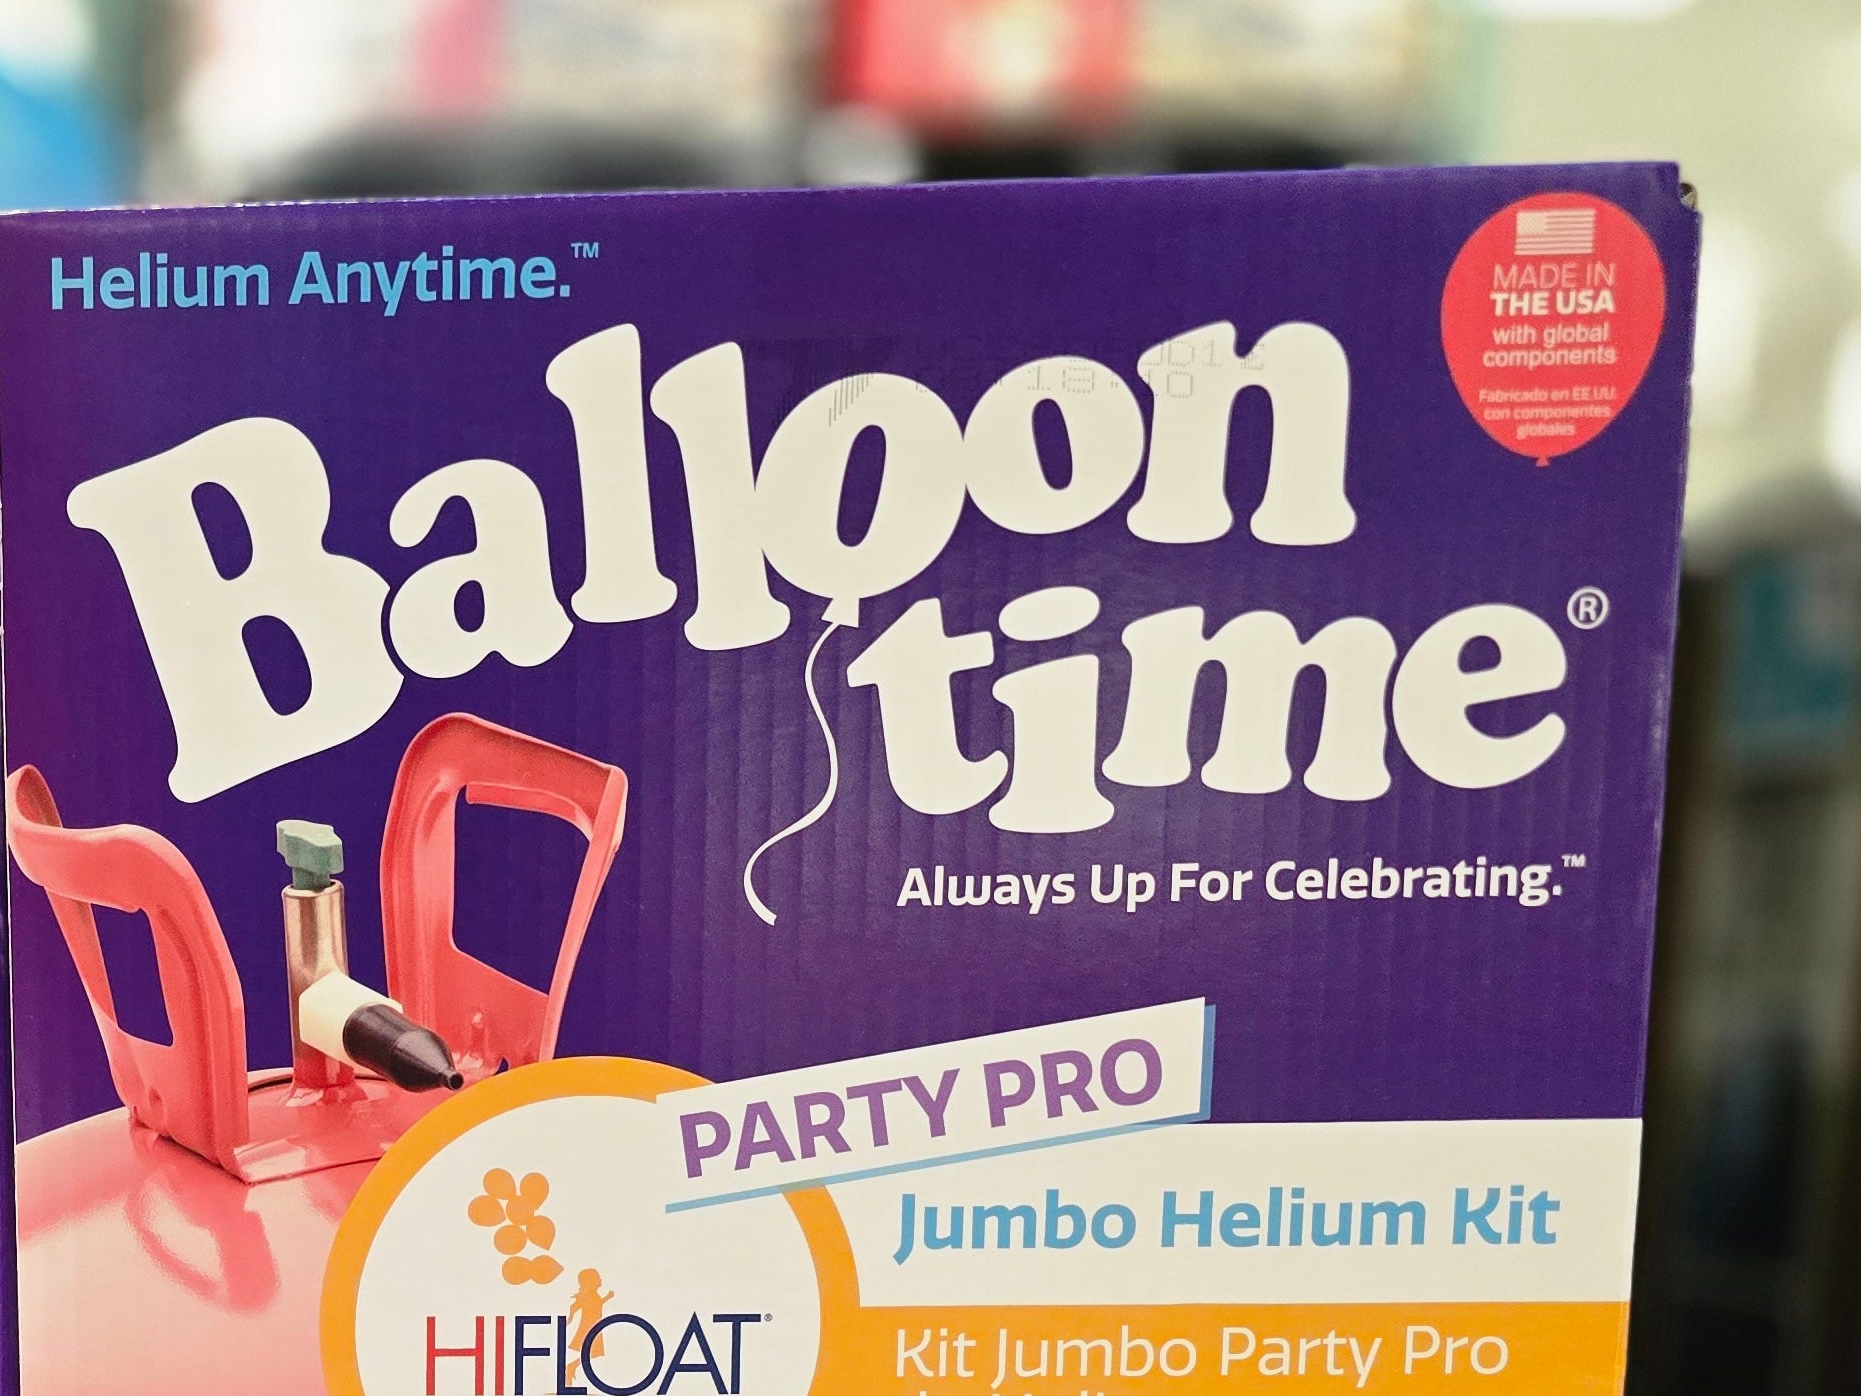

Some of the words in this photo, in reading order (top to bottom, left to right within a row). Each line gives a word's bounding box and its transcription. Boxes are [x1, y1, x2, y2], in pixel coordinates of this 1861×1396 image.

[51, 251, 270, 311] Helium
[1490, 292, 1550, 317] THE
[1556, 290, 1615, 315] USA
[1493, 263, 1578, 290] MADE
[1586, 262, 1616, 287] IN
[1483, 346, 1617, 370] components
[1492, 324, 1535, 345] with
[1543, 322, 1610, 348] global
[66, 320, 1357, 803] Balloon
[896, 865, 1076, 915] Always
[1090, 863, 1156, 911] Up
[1170, 862, 1254, 902] For
[679, 1068, 960, 1179] PARTY
[984, 1038, 1164, 1127] PRO
[892, 1188, 1137, 1266] Jumbo
[1160, 1186, 1427, 1248] Helium
[1451, 1184, 1561, 1245] Kit
[896, 1327, 977, 1378] Kit
[990, 1324, 1197, 1390] Jumbo
[1220, 1326, 1383, 1389] Party
[1404, 1325, 1509, 1375] Pro
